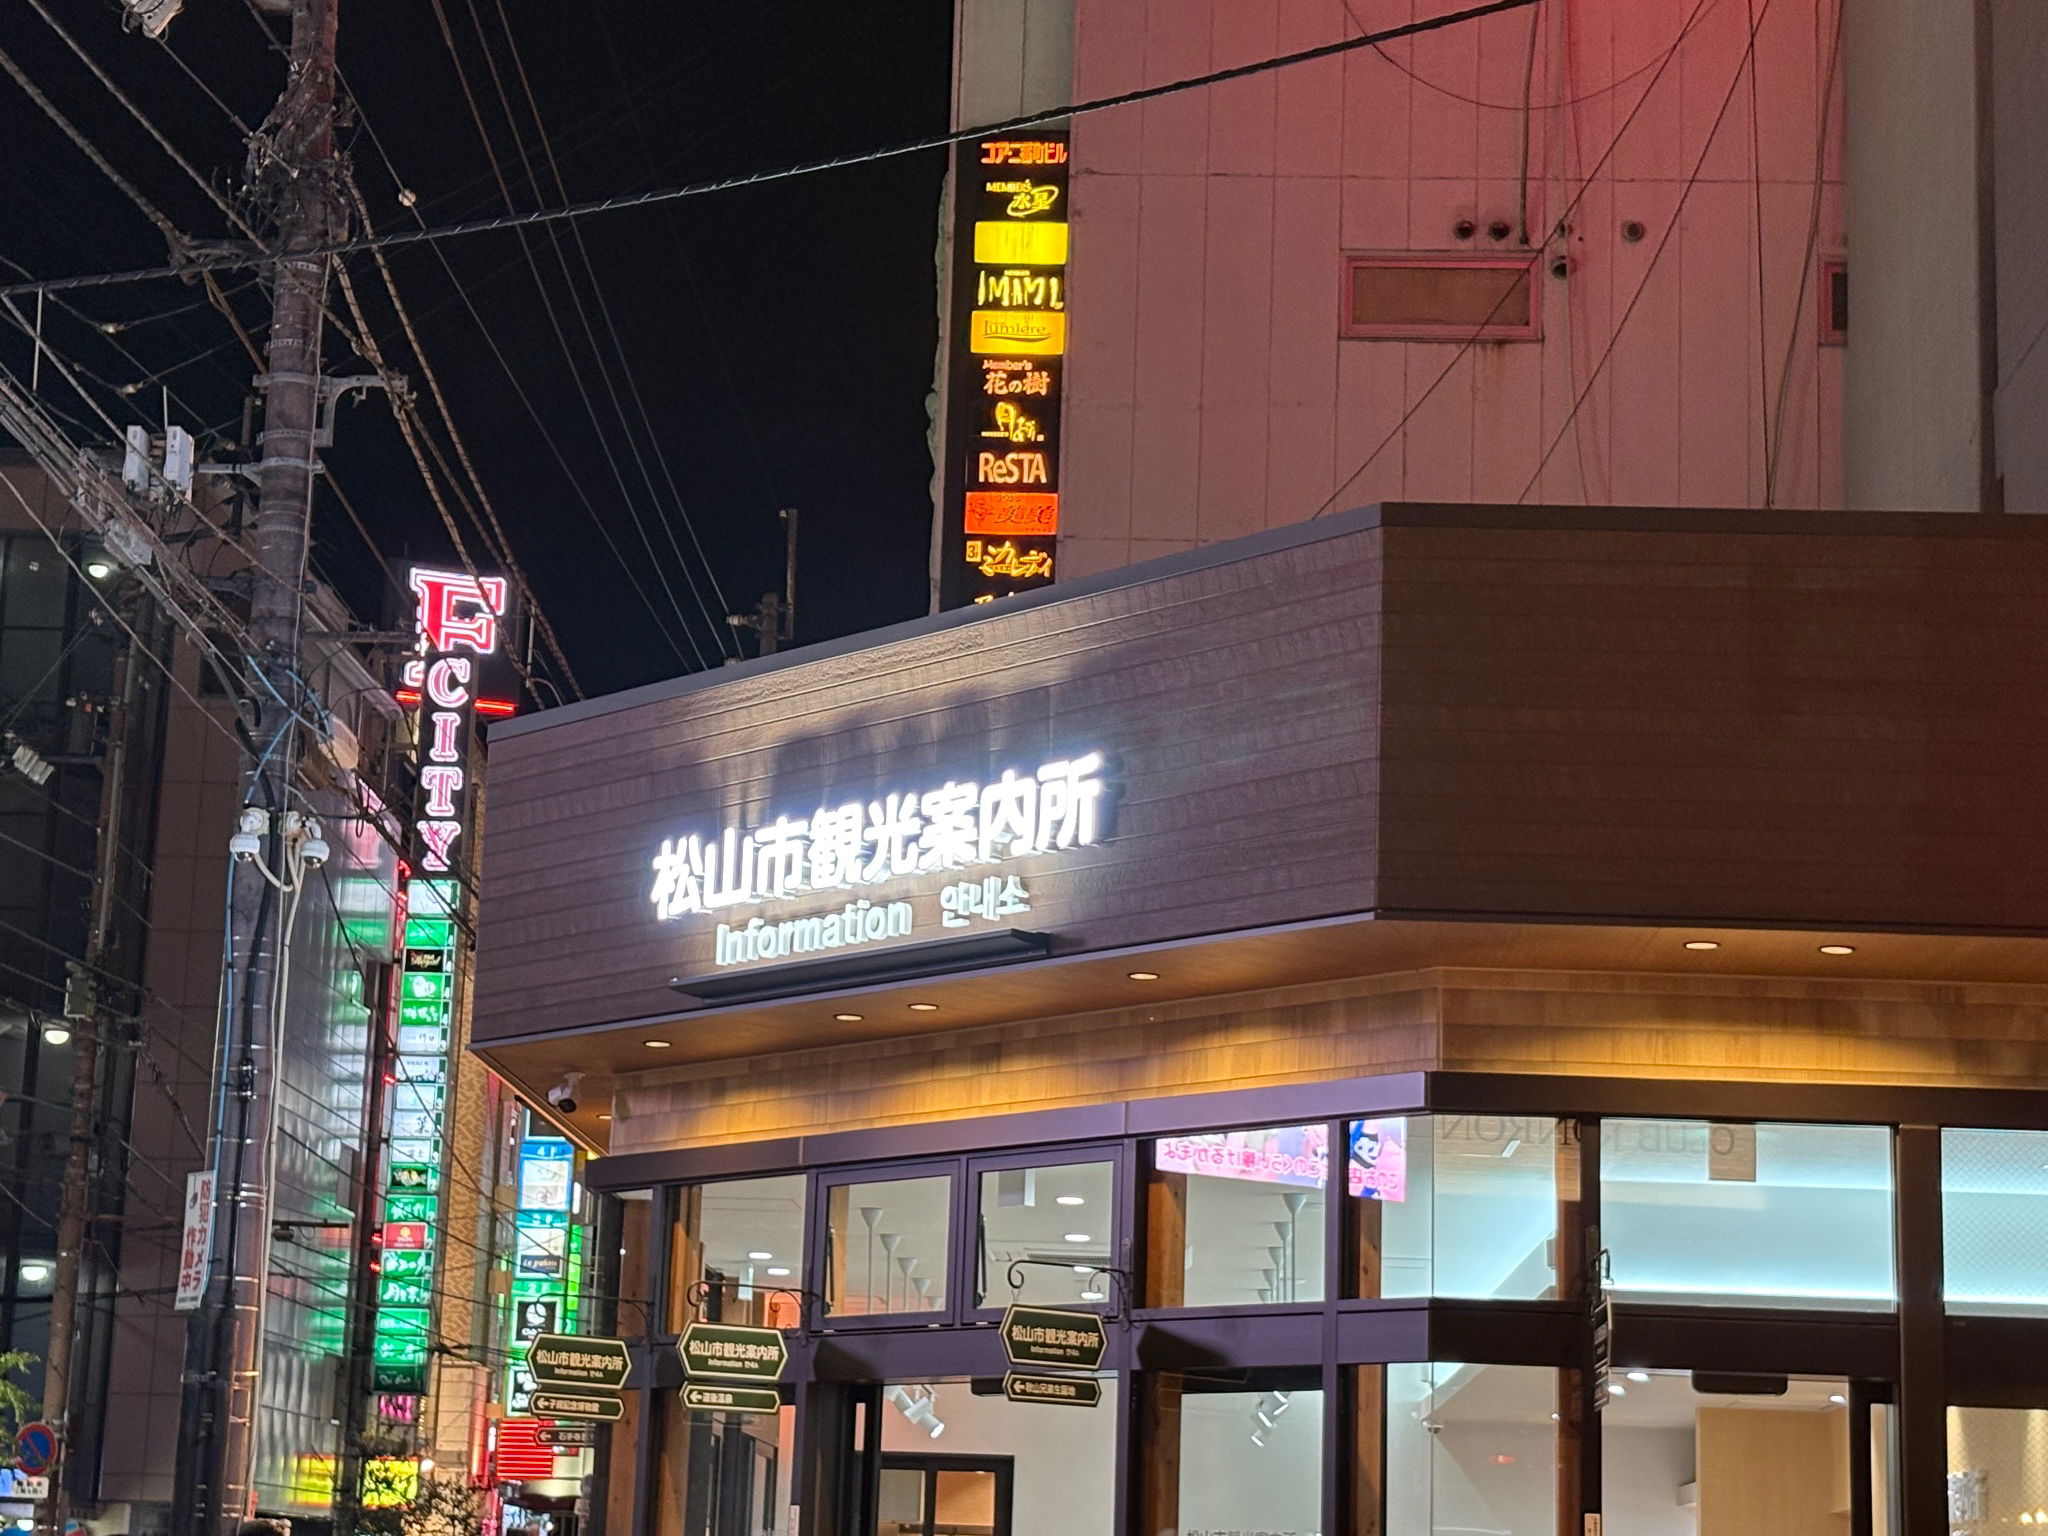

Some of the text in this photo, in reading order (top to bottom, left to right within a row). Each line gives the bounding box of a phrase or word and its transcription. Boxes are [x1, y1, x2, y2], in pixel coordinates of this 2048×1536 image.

[983, 370, 1051, 396] 花の樹
[978, 452, 1048, 484] ReSTA
[651, 752, 1103, 920] 松山市観光案内所
[716, 874, 1030, 966] Information 안내소
[192, 1179, 211, 1290] 防犯カメラ
[181, 1226, 196, 1291] 作動中
[689, 1340, 779, 1361] 松山市観光案内所
[1011, 1324, 1099, 1348] 松山市観光案内所
[536, 1349, 624, 1371] 松山市観光案内所
